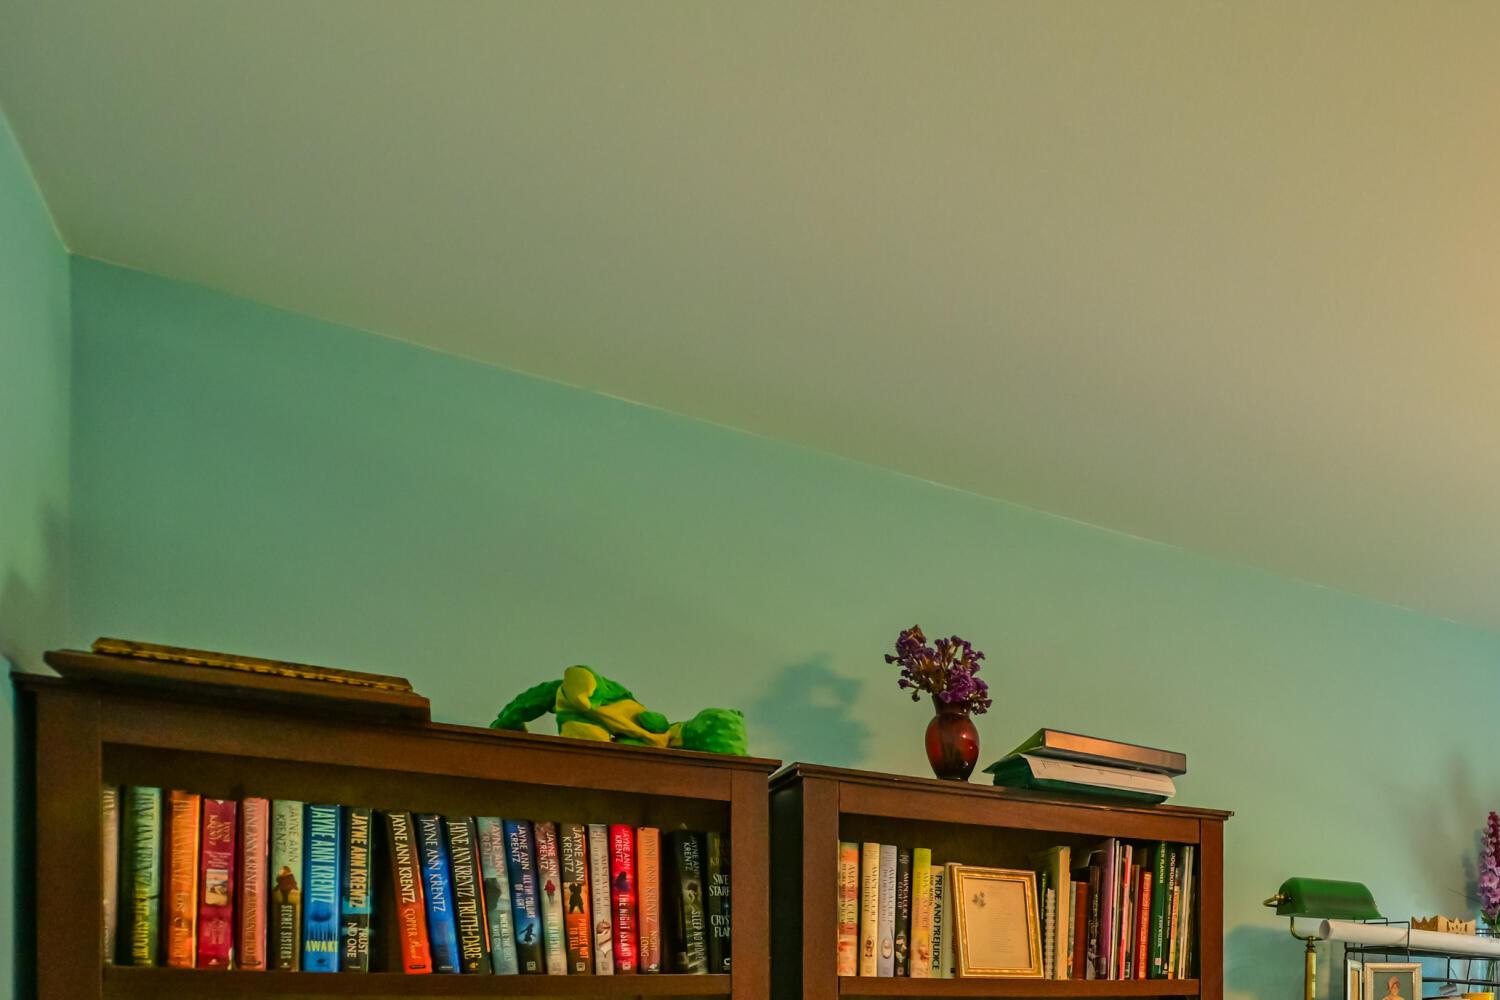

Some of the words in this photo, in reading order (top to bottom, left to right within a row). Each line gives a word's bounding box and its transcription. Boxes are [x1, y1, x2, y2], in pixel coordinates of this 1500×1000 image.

[288, 805, 298, 837] JAYNE
[310, 806, 335, 837] JAYNE
[351, 813, 368, 844] JAYNE
[388, 813, 406, 840] JAYNE
[420, 820, 434, 846] JAYNE
[447, 822, 467, 845] JAYNE
[275, 815, 286, 853] KRENTZ
[517, 825, 528, 850] JAYNE
[545, 832, 555, 856] JAYNE
[572, 827, 584, 856] JAYNE
[289, 840, 299, 863] ANN
[310, 841, 335, 862] ANN
[351, 846, 368, 866] ANN
[396, 843, 409, 865] ANN
[427, 849, 439, 870] ANN
[452, 846, 472, 865] ANN
[511, 832, 520, 863] KRENTZ
[538, 839, 549, 870] KRENTZ
[562, 836, 573, 872] KRENTZ
[521, 852, 529, 870] ANN
[549, 859, 557, 876] ANN
[576, 859, 585, 881] ANN
[245, 856, 257, 892] KRENTZ
[310, 866, 335, 904] KRENTZ
[399, 867, 415, 903] KRENTZ
[454, 866, 475, 896] KRENTZ
[350, 869, 368, 908] KRENTZ
[429, 874, 446, 912] KRENTZ
[619, 894, 629, 906] THE
[934, 874, 942, 902] PRIDE
[281, 905, 292, 929] SECRET
[404, 909, 418, 936] COPPER
[458, 899, 478, 932] TRUTH
[620, 908, 630, 929] NIGHT
[691, 911, 703, 929] SLEEP
[934, 903, 942, 923] AND
[347, 922, 358, 936] NO
[358, 927, 368, 953] TRUST
[281, 931, 292, 960] SISTERS
[305, 940, 338, 952] AWAKE
[347, 939, 358, 958] ONE
[462, 936, 481, 960] DARE
[620, 932, 631, 956] ISLAND
[641, 936, 649, 957] LONG
[932, 925, 941, 970] PREJUDICE
